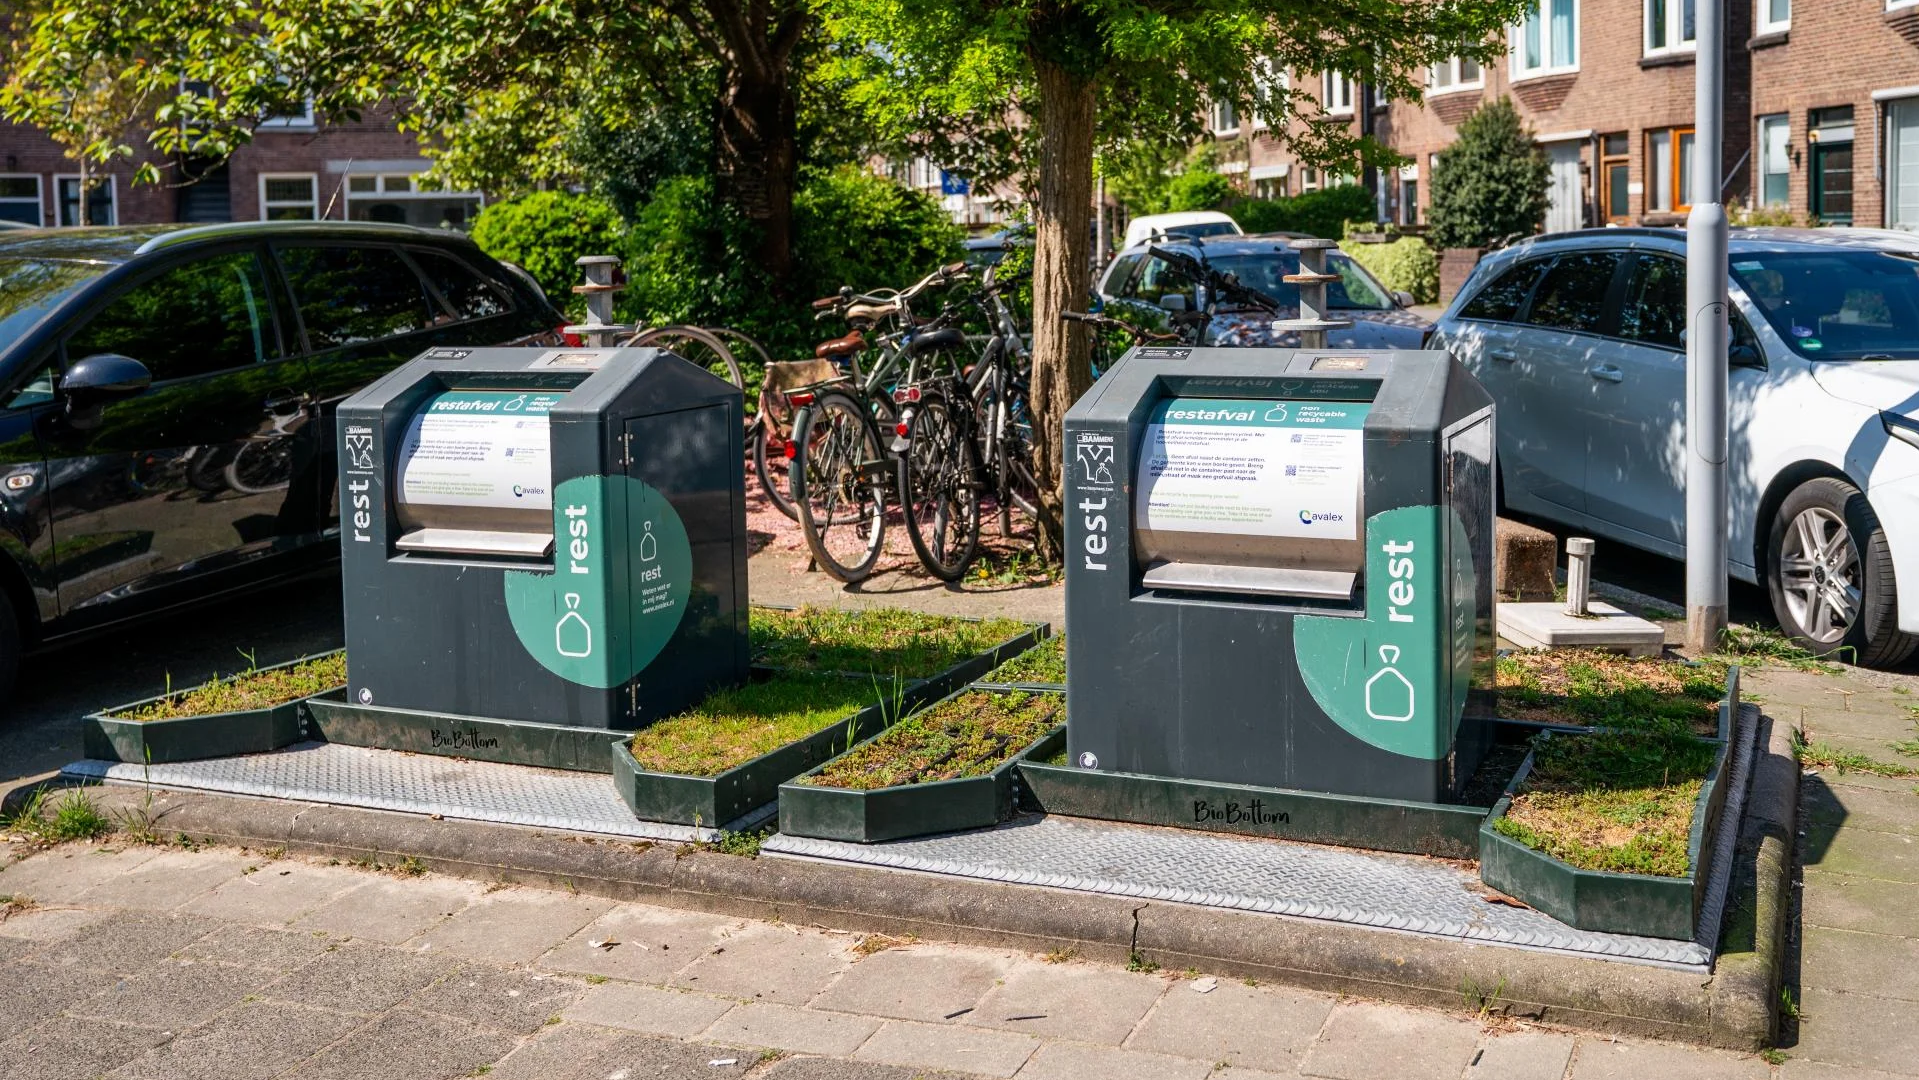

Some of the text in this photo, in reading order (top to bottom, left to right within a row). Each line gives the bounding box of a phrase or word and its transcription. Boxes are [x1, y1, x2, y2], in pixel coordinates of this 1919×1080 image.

[431, 400, 501, 411] restafval
[1165, 409, 1256, 421] restafval
[1082, 434, 1114, 443] BAMMENS
[522, 486, 545, 495] avalex
[349, 480, 371, 542] rest
[1312, 512, 1344, 522] avalex
[564, 504, 589, 574] rest
[1079, 498, 1108, 570] rest
[641, 566, 662, 582] rest
[1382, 540, 1414, 623] rest
[642, 586, 657, 596] Weten
[657, 584, 666, 592] wat
[430, 727, 499, 750] BioBottom
[1194, 798, 1290, 825] BioBottom
